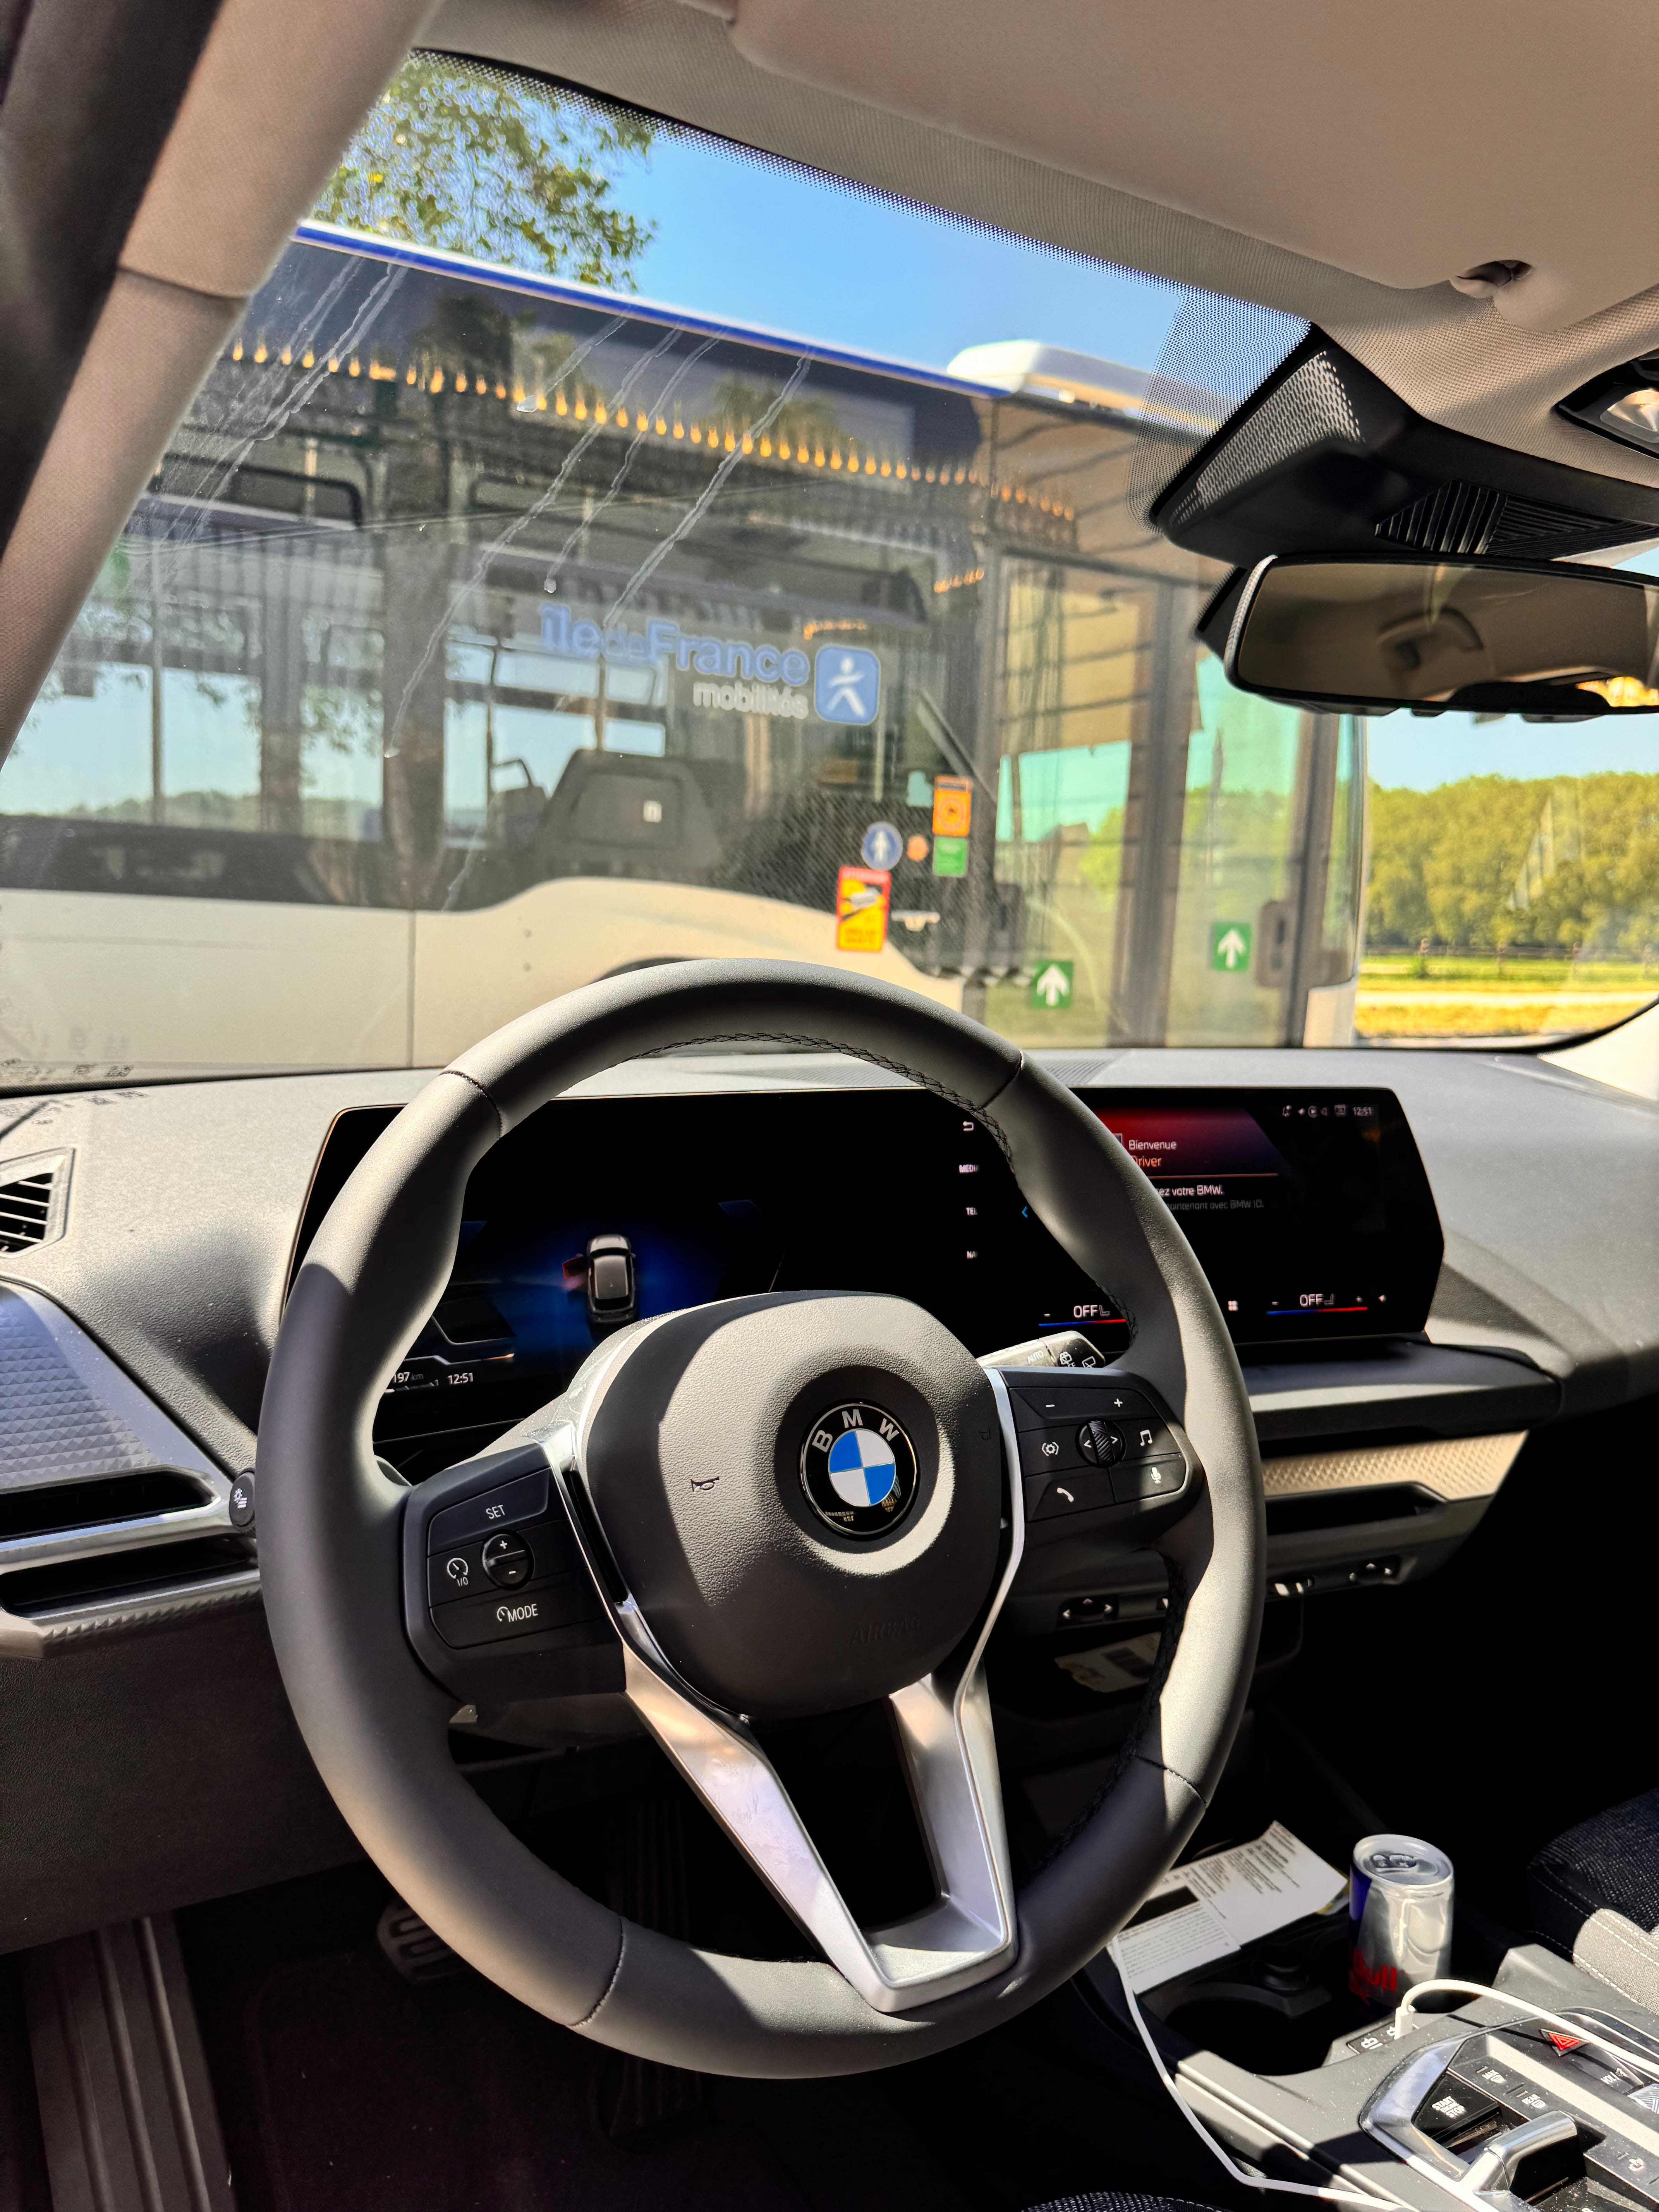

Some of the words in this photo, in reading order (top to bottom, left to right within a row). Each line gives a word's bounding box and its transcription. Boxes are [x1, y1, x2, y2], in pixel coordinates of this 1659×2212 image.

[1352, 1106, 1372, 1116] 12:51
[1129, 1139, 1178, 1151] Bienvenue
[1171, 1187, 1194, 1197] votre
[1197, 1185, 1225, 1196] BMW.
[1210, 1201, 1228, 1209] avec
[1230, 1200, 1251, 1209] BMW
[1300, 1293, 1324, 1308] OFF
[1073, 1304, 1098, 1319] OFF
[1027, 1350, 1044, 1364] AUTO
[447, 1372, 473, 1385] 12:51
[812, 1409, 900, 1453] BMW
[486, 1504, 505, 1520] SET
[507, 1603, 539, 1623] MODE
[1432, 2096, 1455, 2111] START
[1446, 2105, 1465, 2118] STOP
